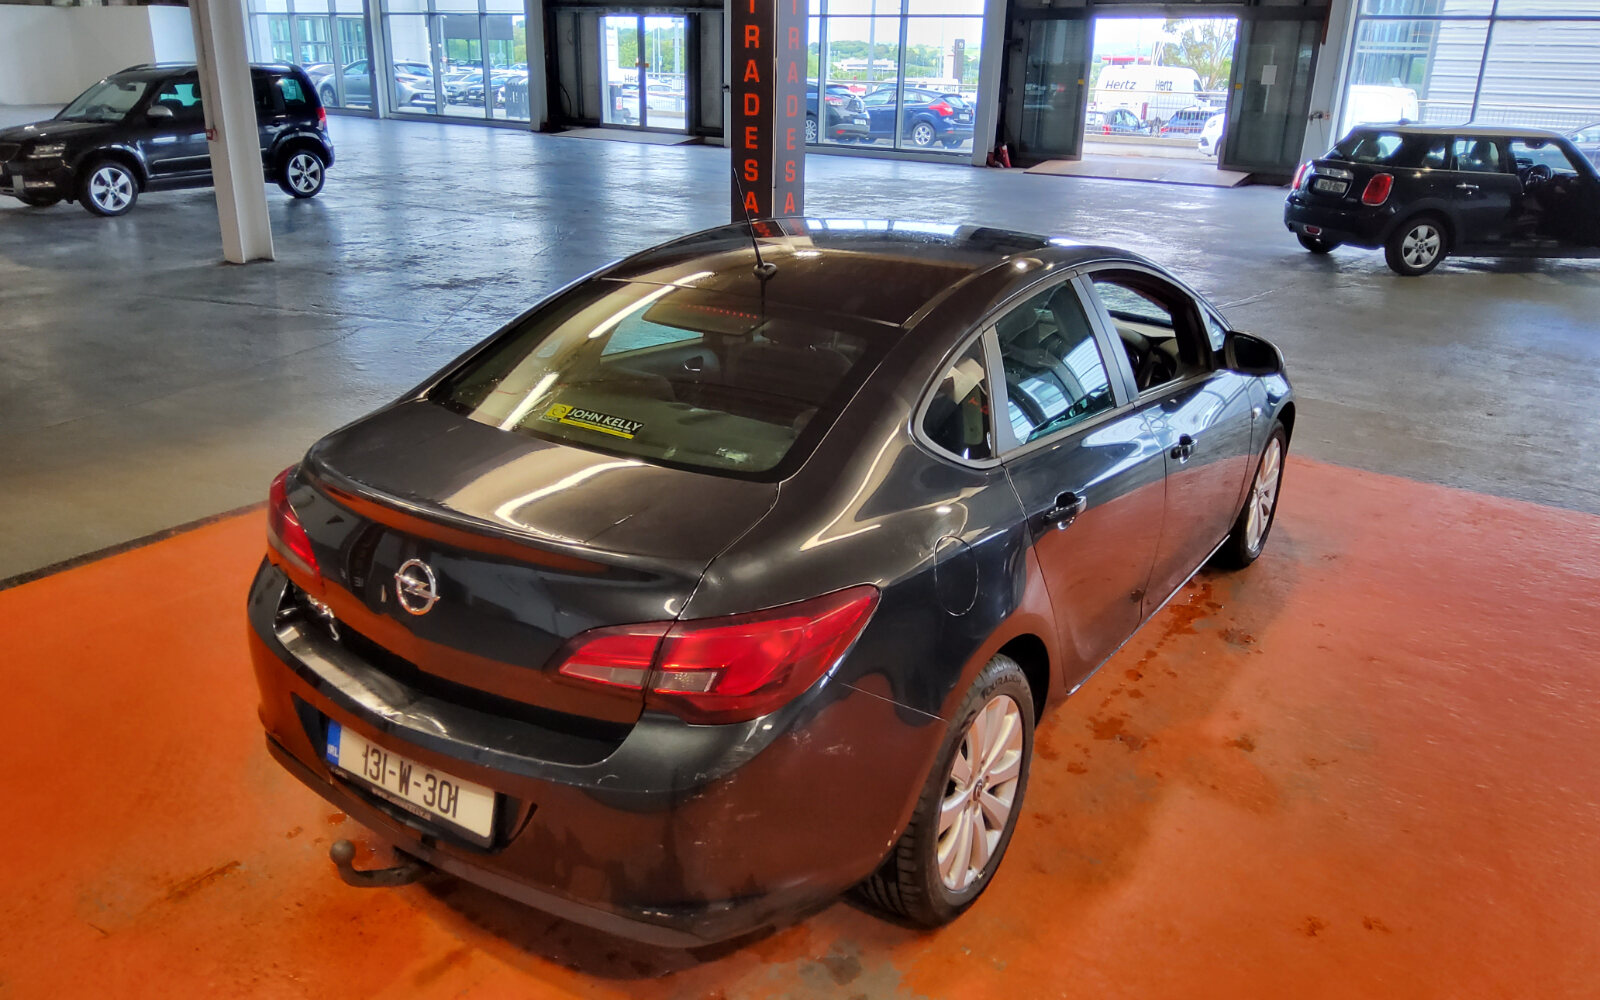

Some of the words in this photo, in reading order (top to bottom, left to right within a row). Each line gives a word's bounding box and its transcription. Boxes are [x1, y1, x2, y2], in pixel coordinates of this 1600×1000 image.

[1105, 79, 1137, 90] Hertz
[1155, 79, 1173, 91] Hertz
[568, 408, 604, 423] JOHN
[602, 415, 643, 431] KELLY
[327, 744, 339, 758] IRL
[361, 743, 460, 819] 131-W-301
